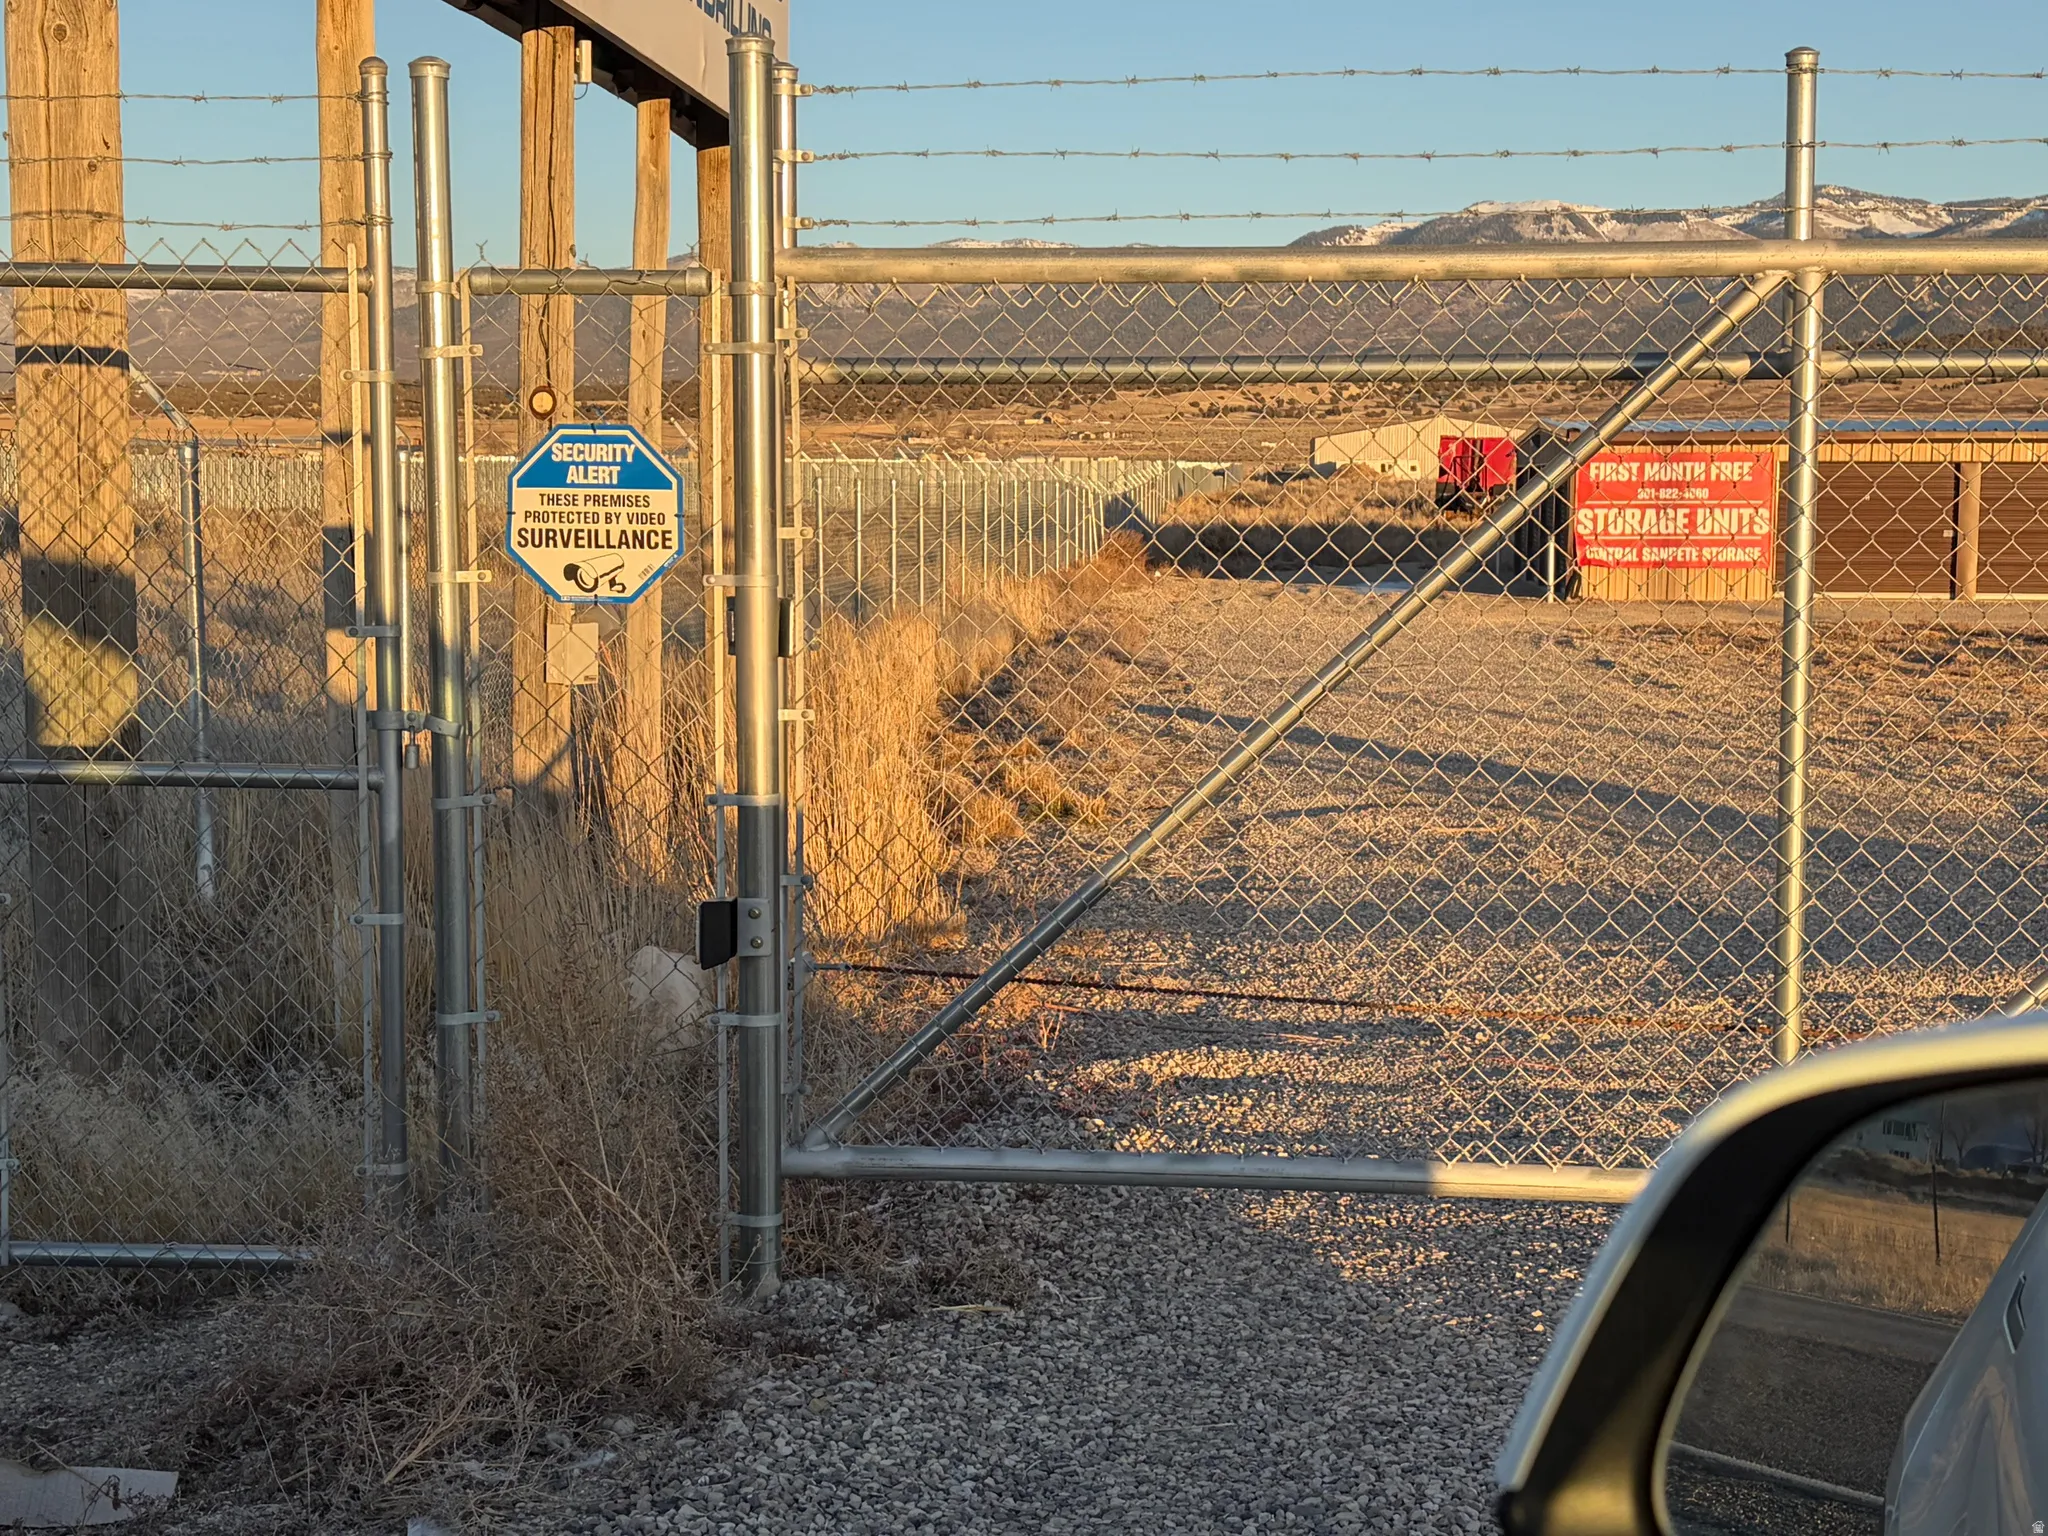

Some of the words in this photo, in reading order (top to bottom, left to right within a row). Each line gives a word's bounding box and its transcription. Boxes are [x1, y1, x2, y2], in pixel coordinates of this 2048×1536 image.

[551, 443, 636, 463] SECURITY
[566, 465, 621, 484] ALERT
[1590, 461, 1640, 482] FIRST
[1644, 461, 1705, 482] MONTH
[1711, 461, 1753, 482] FREE
[539, 493, 579, 507] THESE
[583, 494, 651, 507] PREMISES
[524, 510, 600, 524] PROTECTED
[604, 512, 621, 525] BY
[626, 512, 666, 525] VIDEO
[1577, 507, 1689, 535] STORAGE
[1697, 507, 1770, 535] UNITS
[517, 527, 673, 550] SURVEILLANCE
[1586, 547, 1639, 562] CENTRAL
[1642, 547, 1698, 562] SANPETE
[1702, 547, 1762, 562] STORAGE
